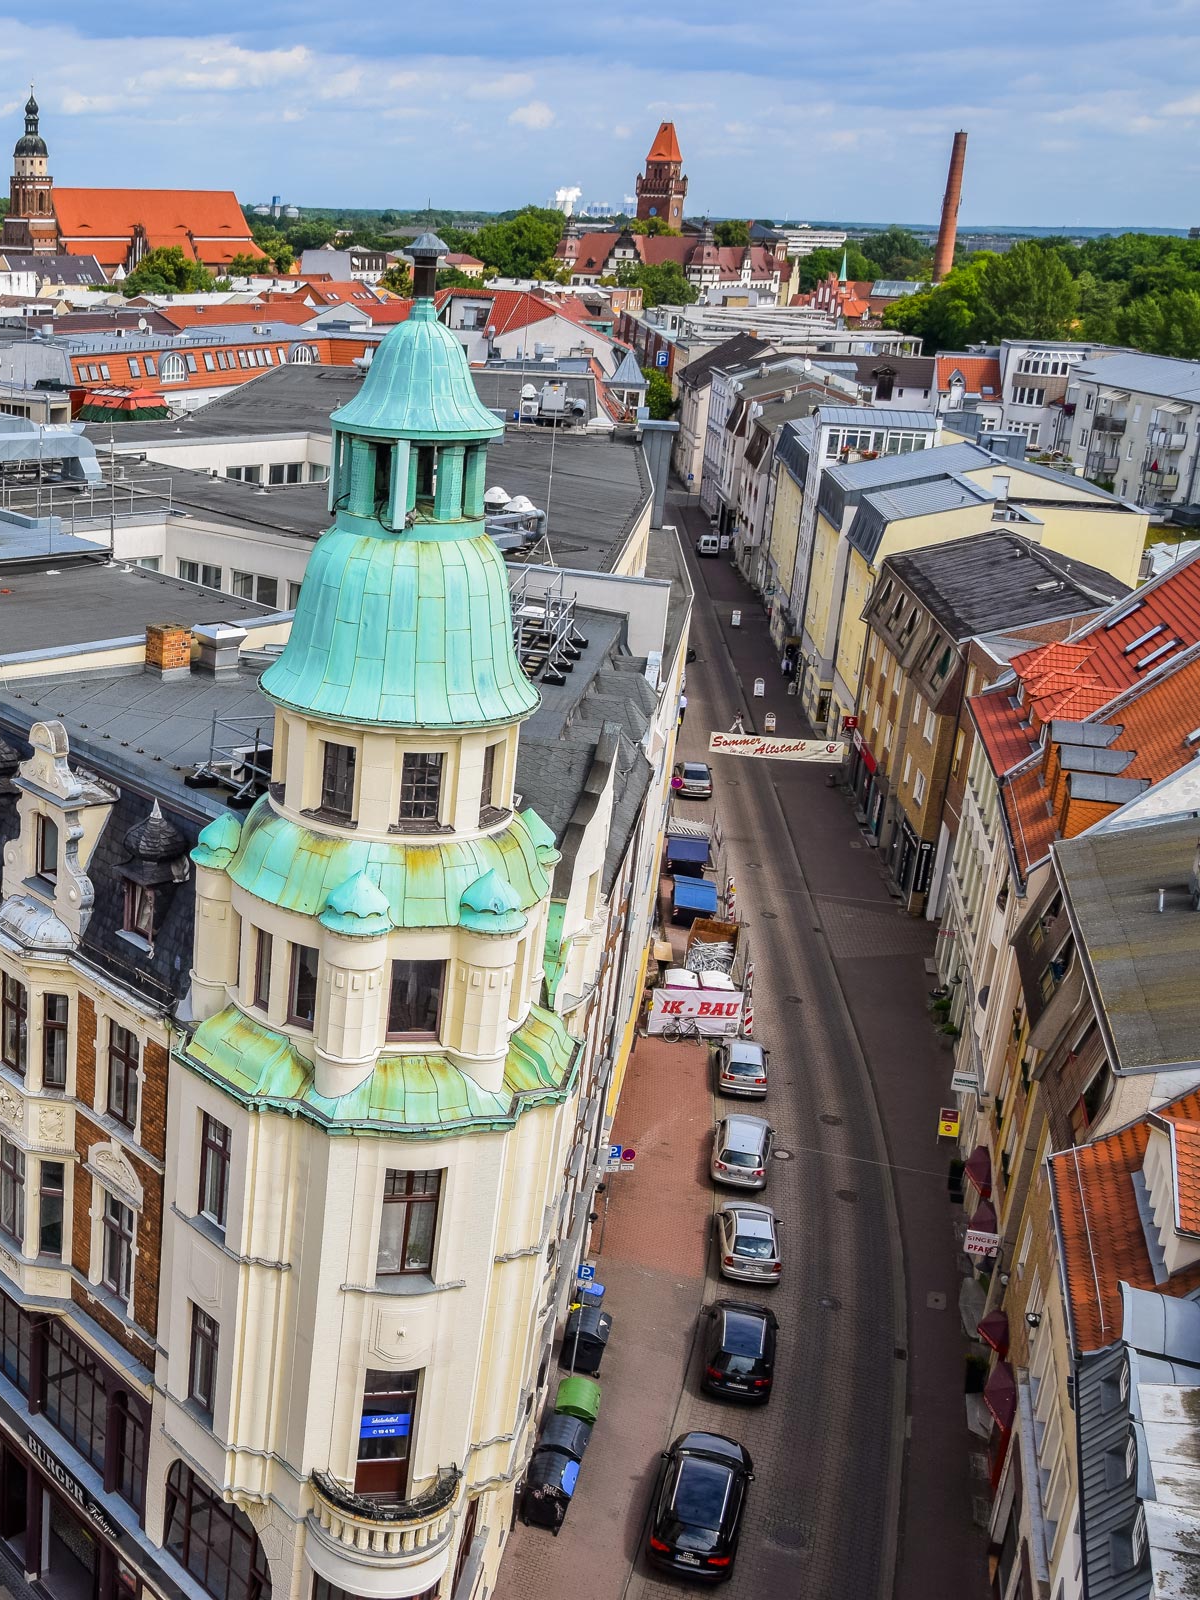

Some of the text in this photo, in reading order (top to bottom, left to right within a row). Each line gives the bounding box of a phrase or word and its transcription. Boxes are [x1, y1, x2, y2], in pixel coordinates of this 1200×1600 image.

[659, 356, 666, 365] P
[711, 736, 761, 747] Sommer
[753, 741, 806, 755] Altstadt
[660, 1000, 685, 1014] IK
[697, 1001, 740, 1016] BAU
[967, 1235, 998, 1245] SINGER
[580, 1267, 591, 1278] P
[27, 1434, 118, 1539] BURGER Fabrique
